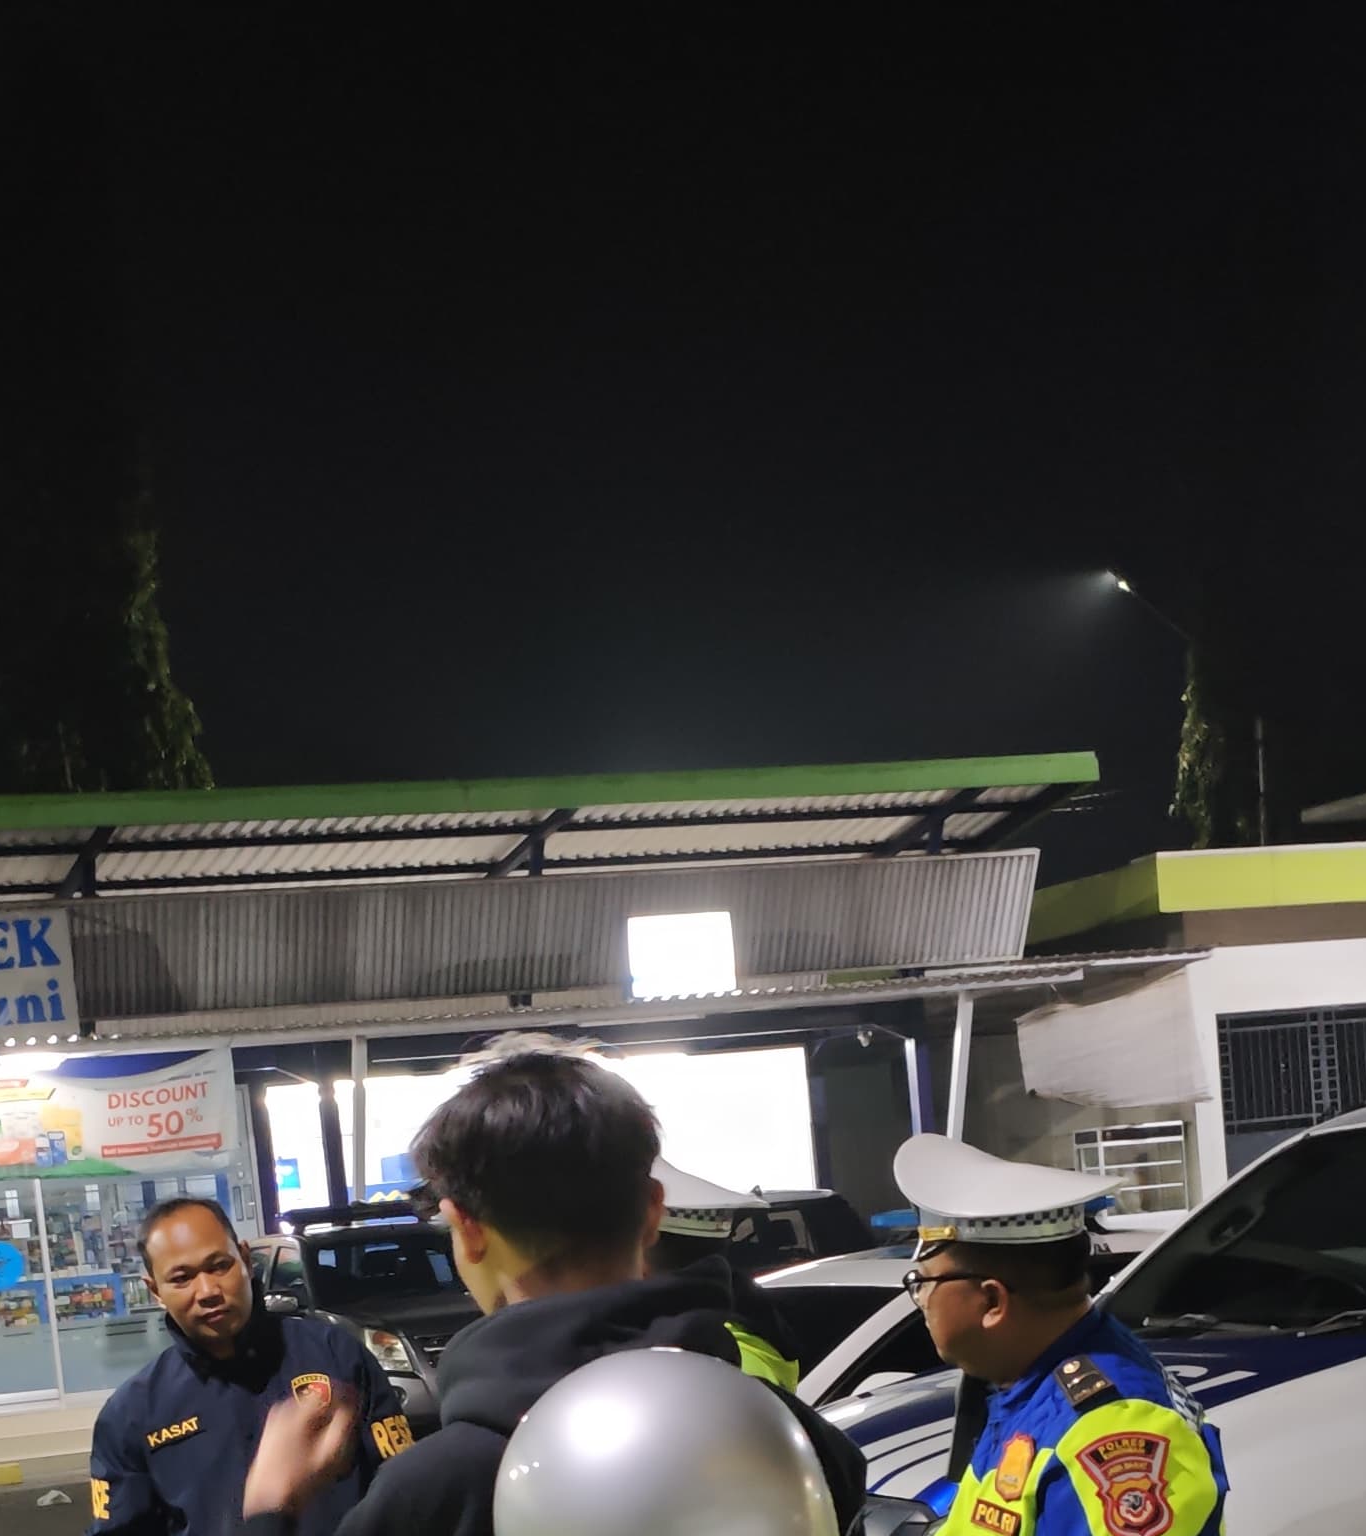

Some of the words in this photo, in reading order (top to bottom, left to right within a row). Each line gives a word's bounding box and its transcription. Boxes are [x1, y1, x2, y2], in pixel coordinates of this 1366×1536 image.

[107, 1081, 209, 1109] DISCOUNT
[108, 1116, 123, 1127] UP
[128, 1115, 144, 1126] TO
[147, 1416, 198, 1447] KASAT
[975, 1504, 1016, 1534] POLRI
